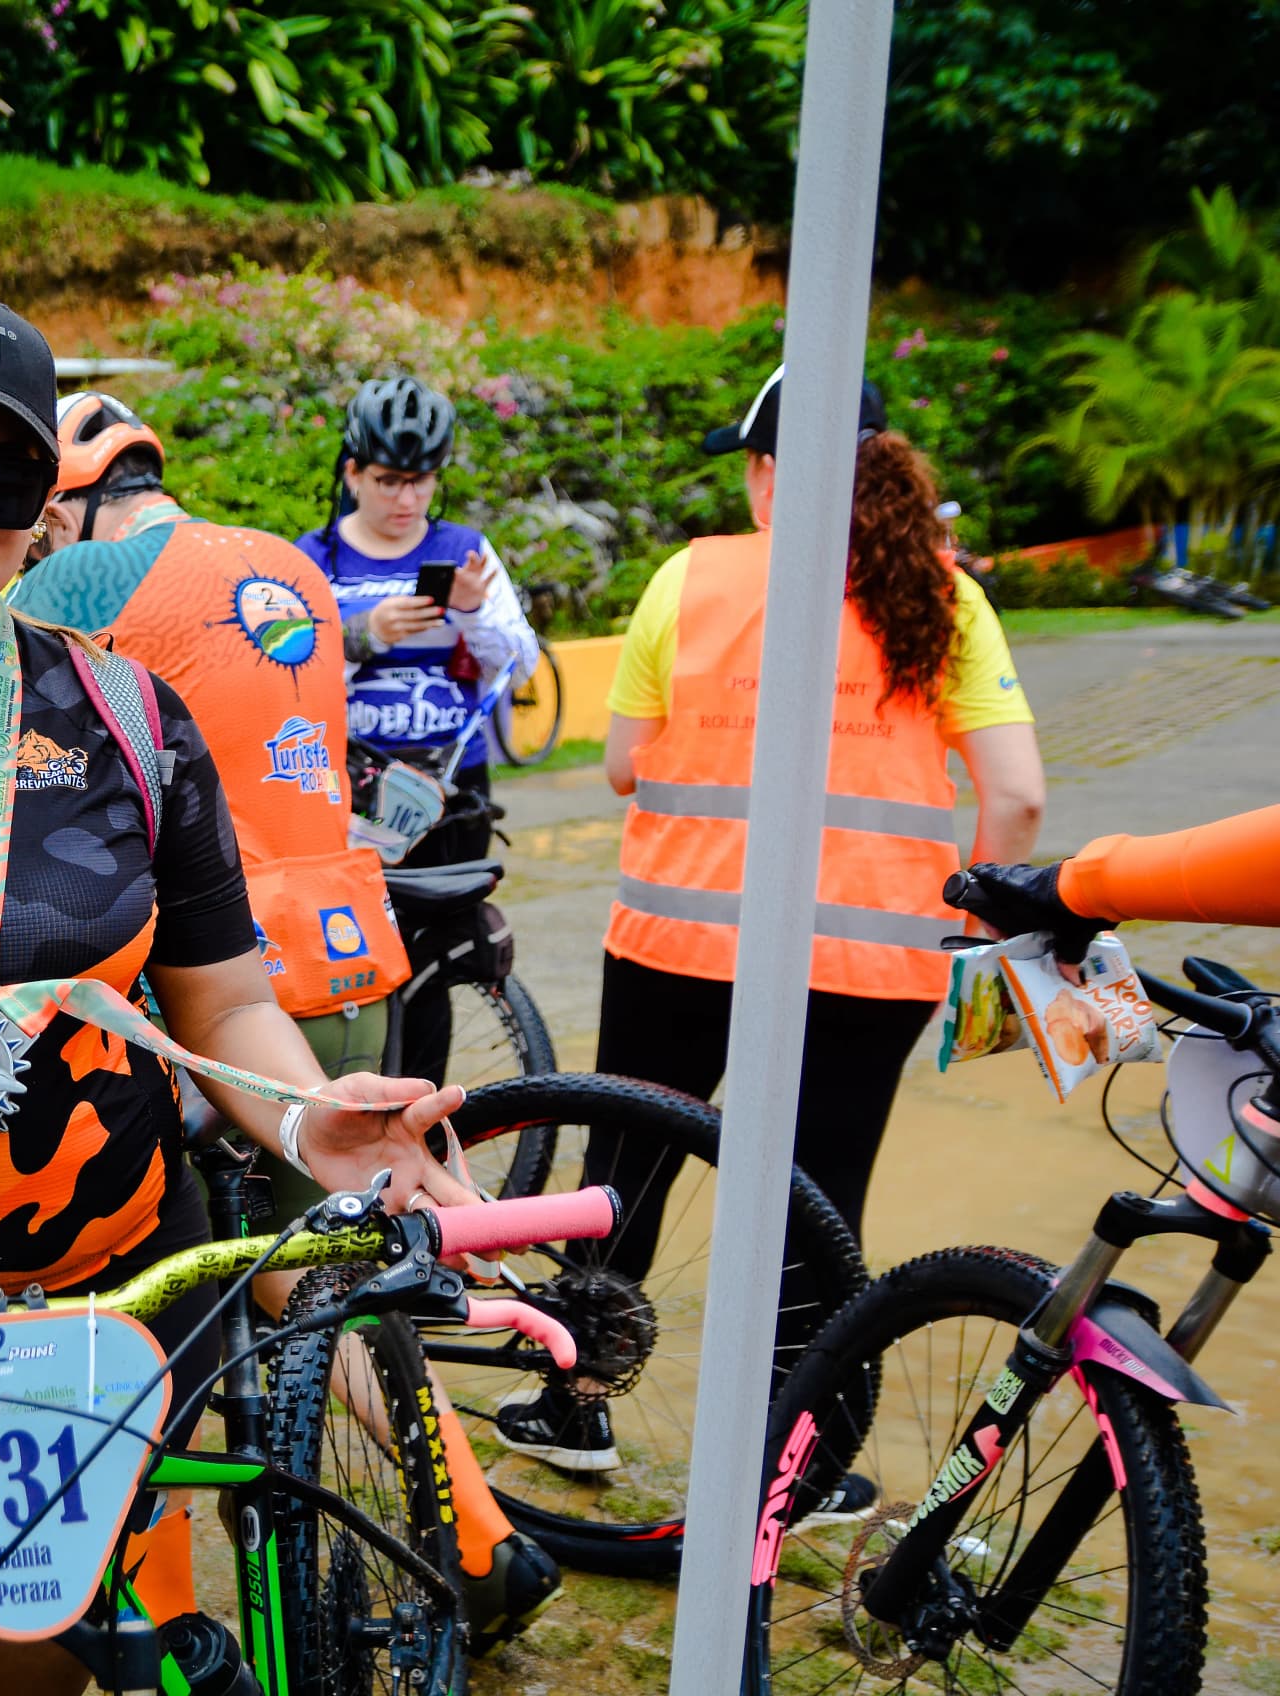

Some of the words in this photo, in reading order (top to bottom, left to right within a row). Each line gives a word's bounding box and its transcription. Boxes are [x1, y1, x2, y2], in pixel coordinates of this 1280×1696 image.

[835, 682, 871, 696] INT
[832, 720, 897, 737] RADISE
[266, 740, 329, 772] Turista
[15, 774, 86, 789] BREVIVIENTES
[39, 769, 66, 779] TEAM
[415, 1386, 454, 1524] MAXXIS
